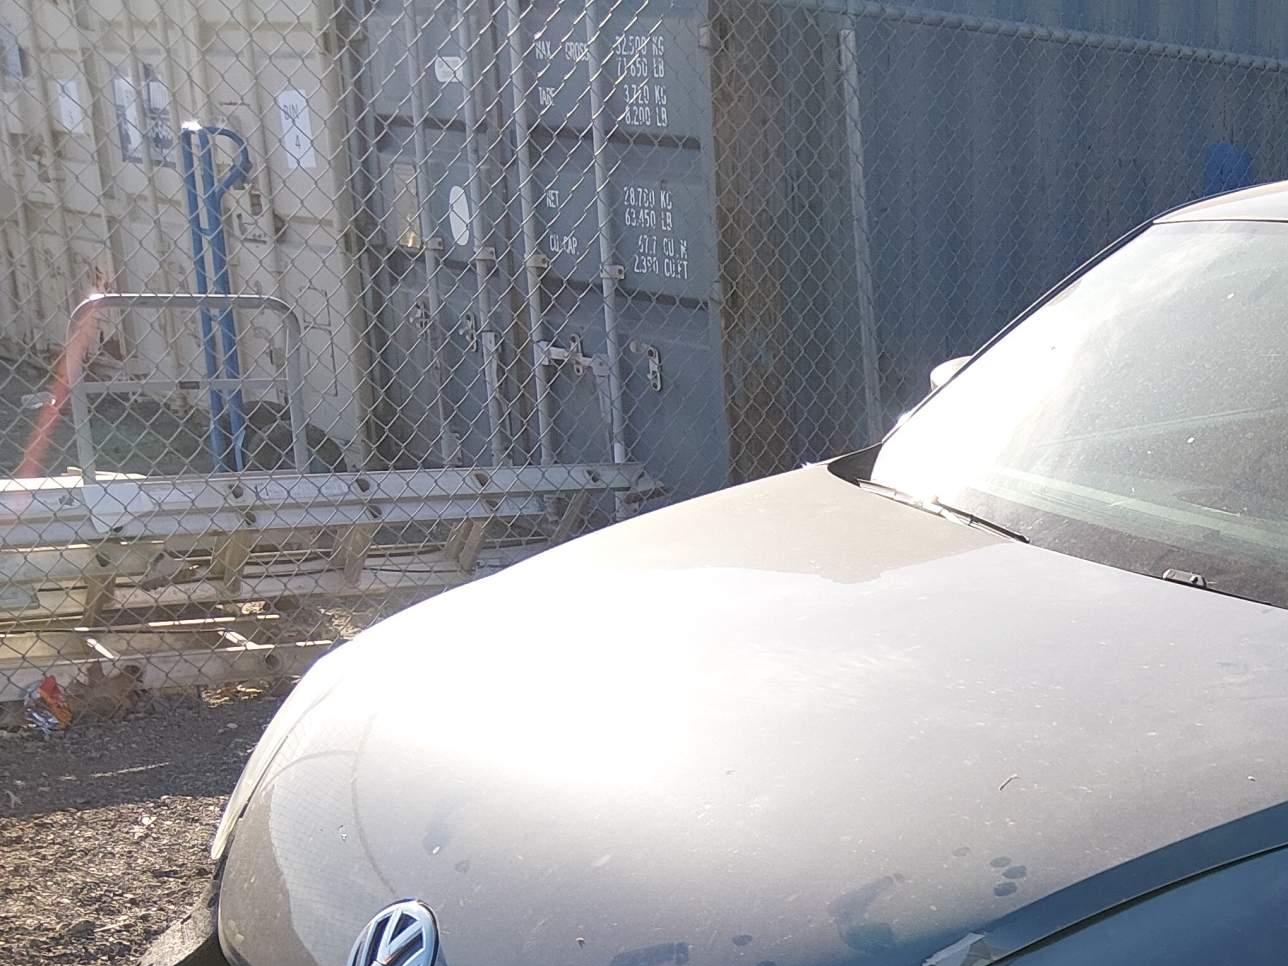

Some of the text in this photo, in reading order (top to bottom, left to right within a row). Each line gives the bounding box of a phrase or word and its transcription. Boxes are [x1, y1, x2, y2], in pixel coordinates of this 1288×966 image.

[652, 36, 665, 56] KG
[653, 58, 665, 78] LB
[656, 107, 667, 127] LB
[546, 190, 559, 208] NET
[660, 190, 672, 210] KG
[661, 212, 672, 231] LB
